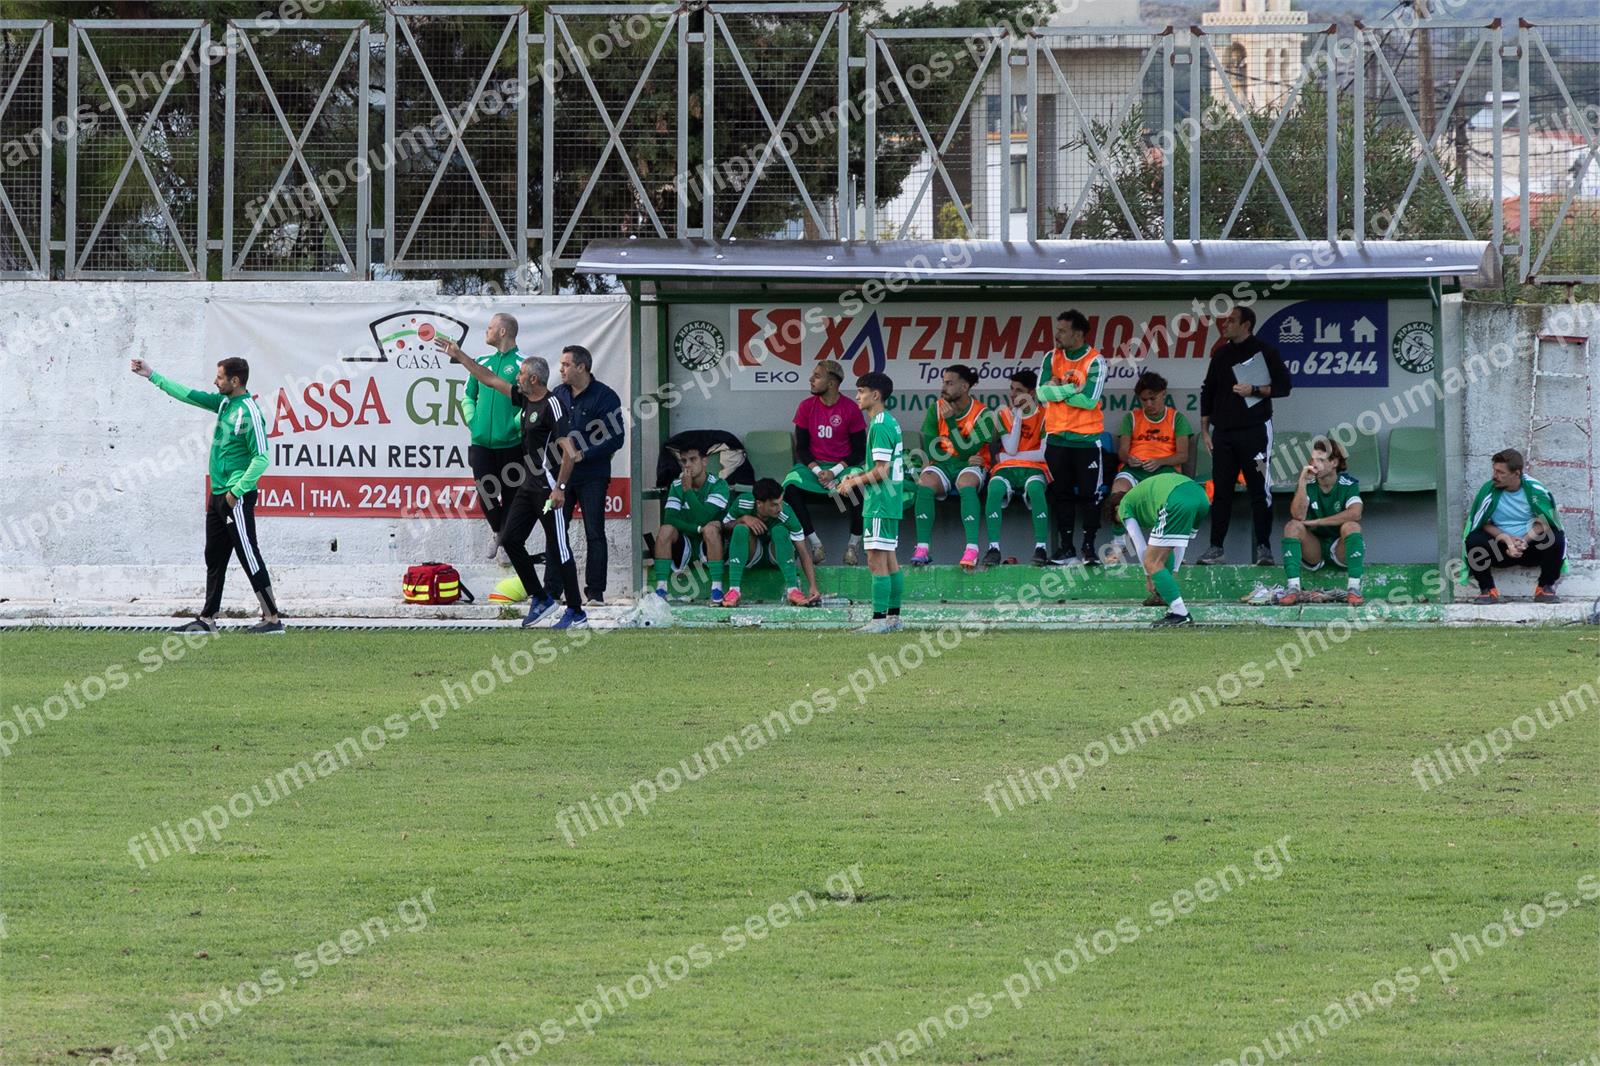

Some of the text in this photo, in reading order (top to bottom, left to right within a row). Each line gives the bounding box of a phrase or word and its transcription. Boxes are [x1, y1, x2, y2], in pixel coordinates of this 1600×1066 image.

[679, 321, 717, 338] ΗΡΑΚΛΗΣ
[397, 354, 441, 370] CASA
[1303, 351, 1378, 374] 62344
[755, 371, 799, 383] EKO
[252, 376, 391, 438] ASSA
[818, 425, 833, 439] 30
[275, 444, 474, 468] ITALIAN RESTA
[256, 488, 295, 507] ΙΔΑ
[310, 489, 351, 508] ΤΗΛ.
[358, 484, 430, 509] 22410
